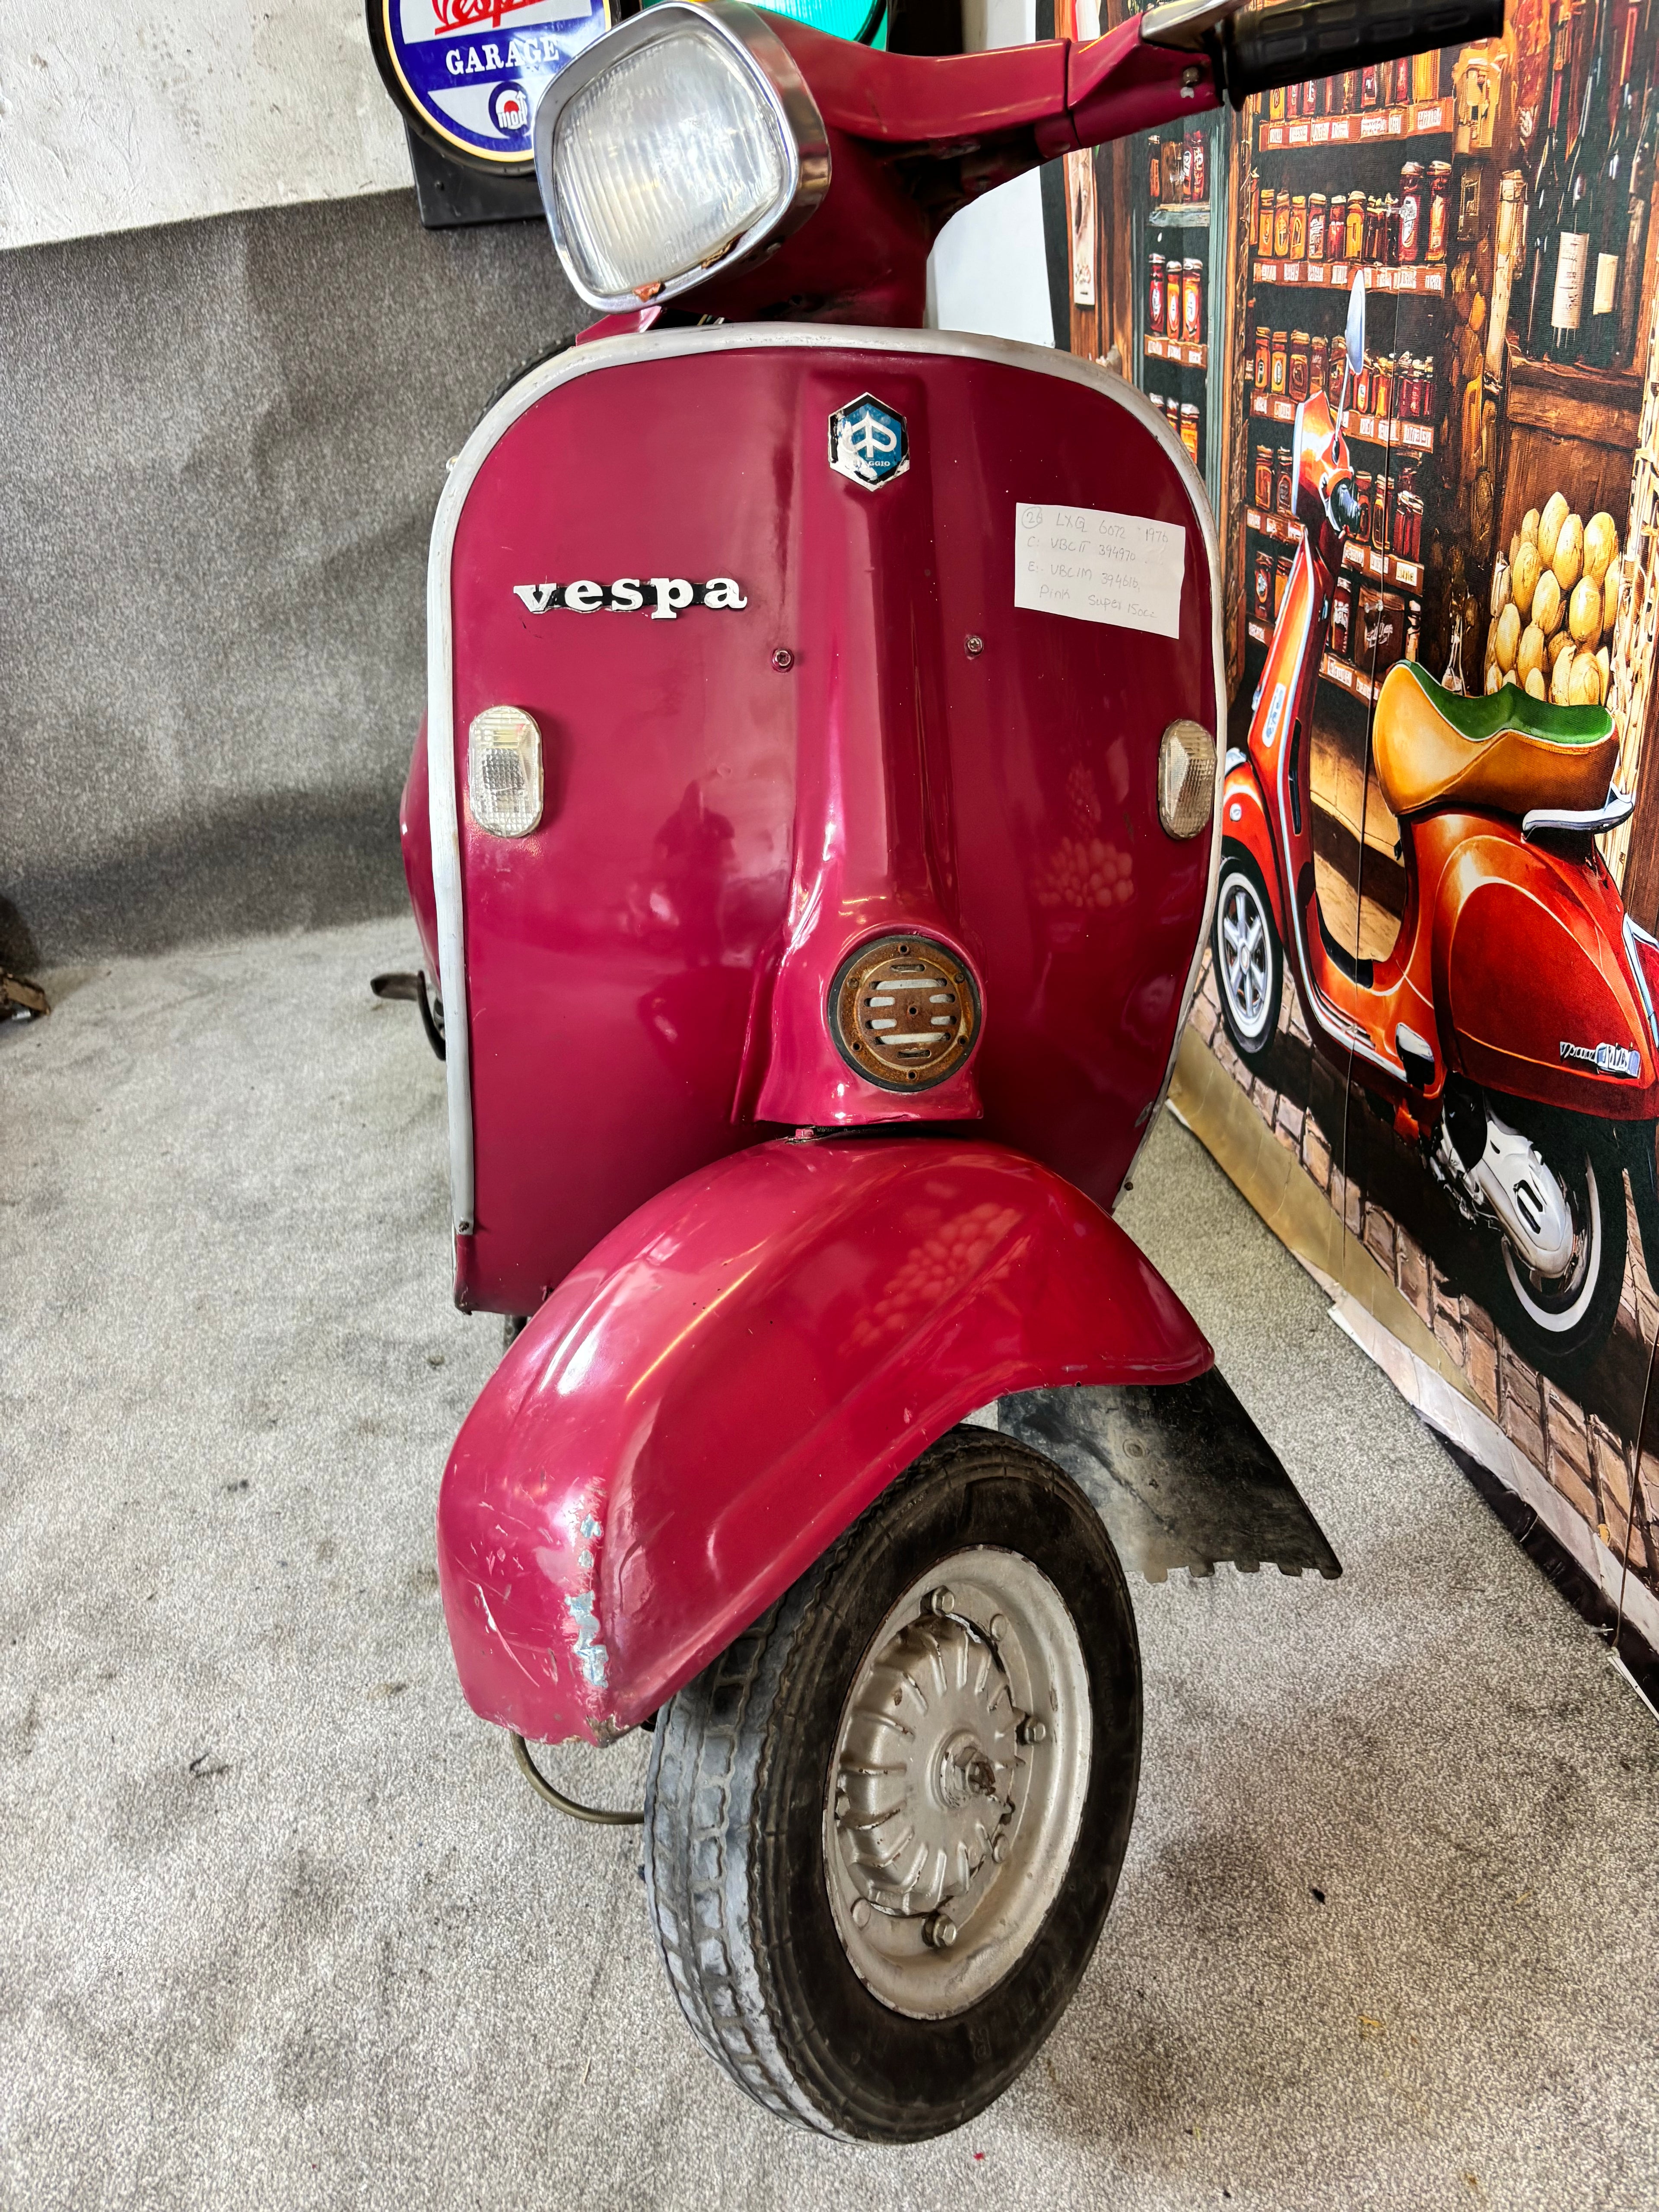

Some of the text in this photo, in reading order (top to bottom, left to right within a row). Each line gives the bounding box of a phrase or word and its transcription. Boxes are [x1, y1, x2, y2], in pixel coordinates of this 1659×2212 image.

[446, 35, 559, 75] GARAGE
[1056, 513, 1087, 532] LXQ
[1100, 520, 1126, 539] 6072
[1146, 528, 1168, 543] 1976
[1099, 544, 1135, 561] 394970
[513, 578, 747, 619] vespa
